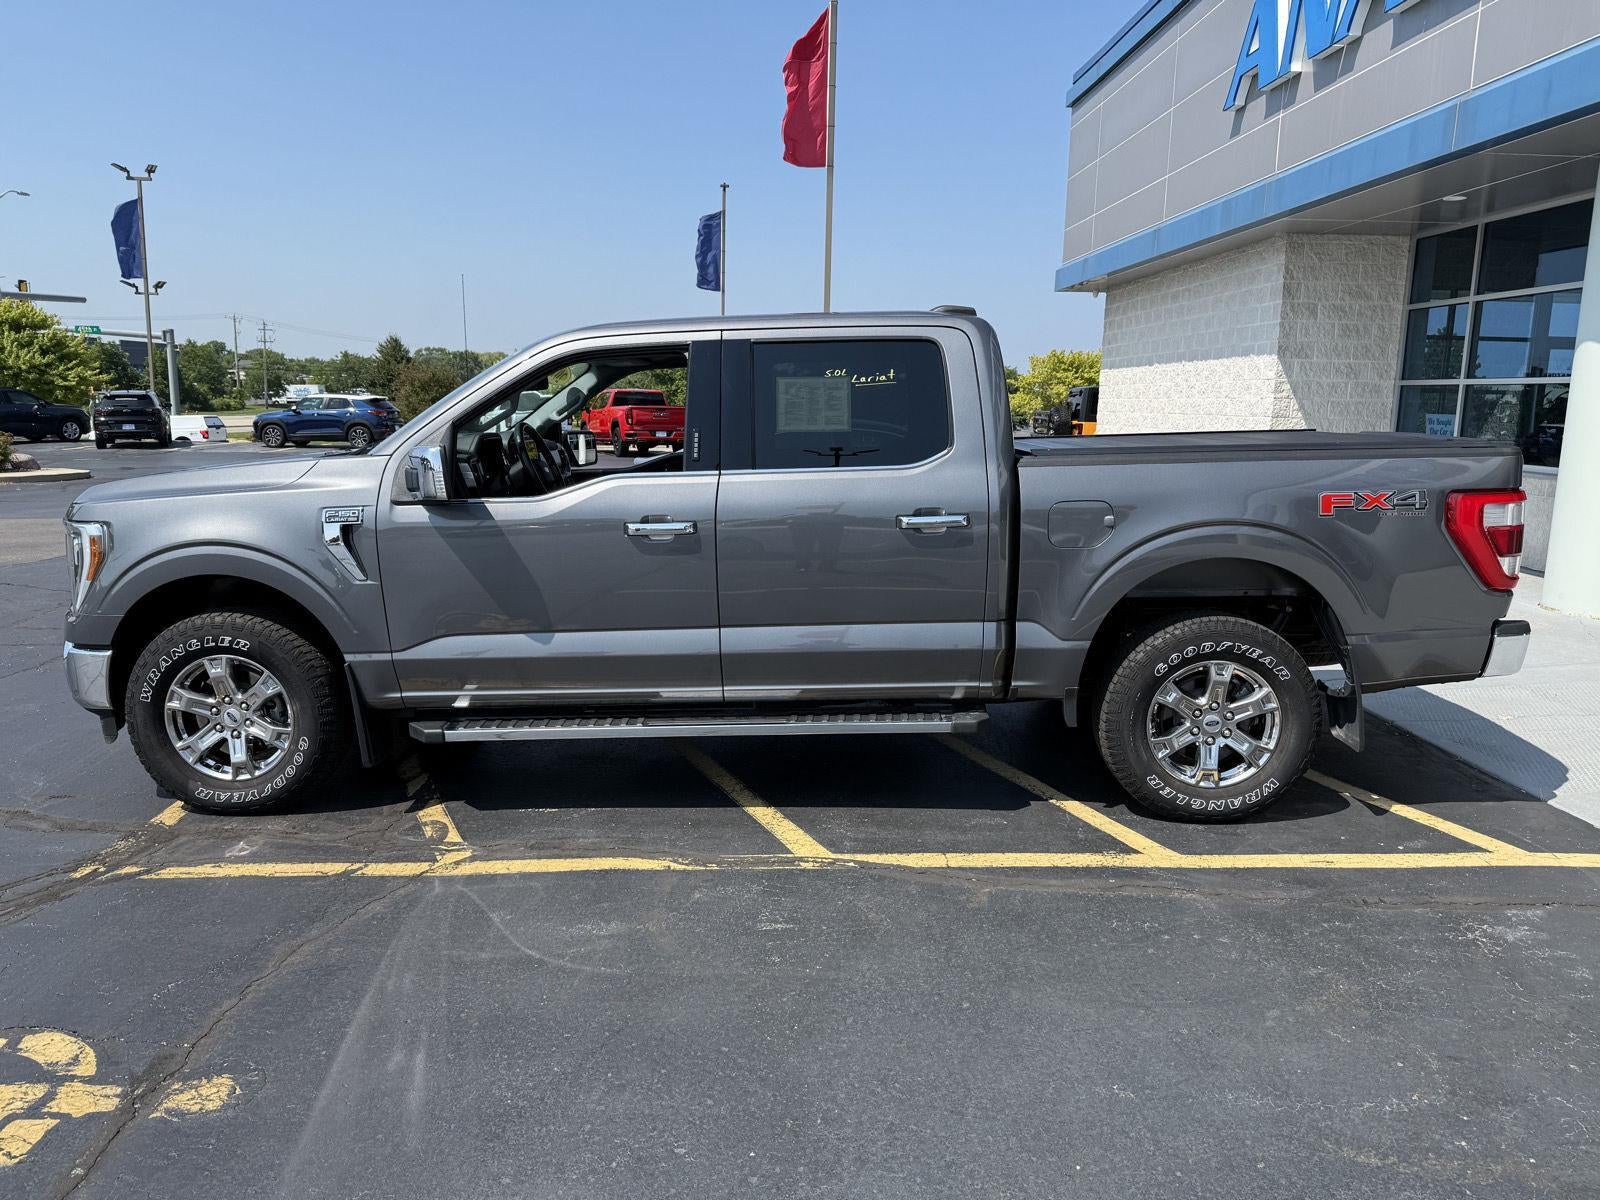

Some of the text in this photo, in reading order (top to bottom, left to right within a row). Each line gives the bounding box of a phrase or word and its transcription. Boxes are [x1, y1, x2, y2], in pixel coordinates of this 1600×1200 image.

[824, 368, 896, 384] 5.0L Lariat
[1318, 489, 1428, 518] FX4
[140, 636, 251, 703] WRANGLER
[1154, 641, 1291, 681] GOODYEAR
[195, 736, 309, 803] GOODYEAR
[1147, 774, 1280, 812] WRANGLER
